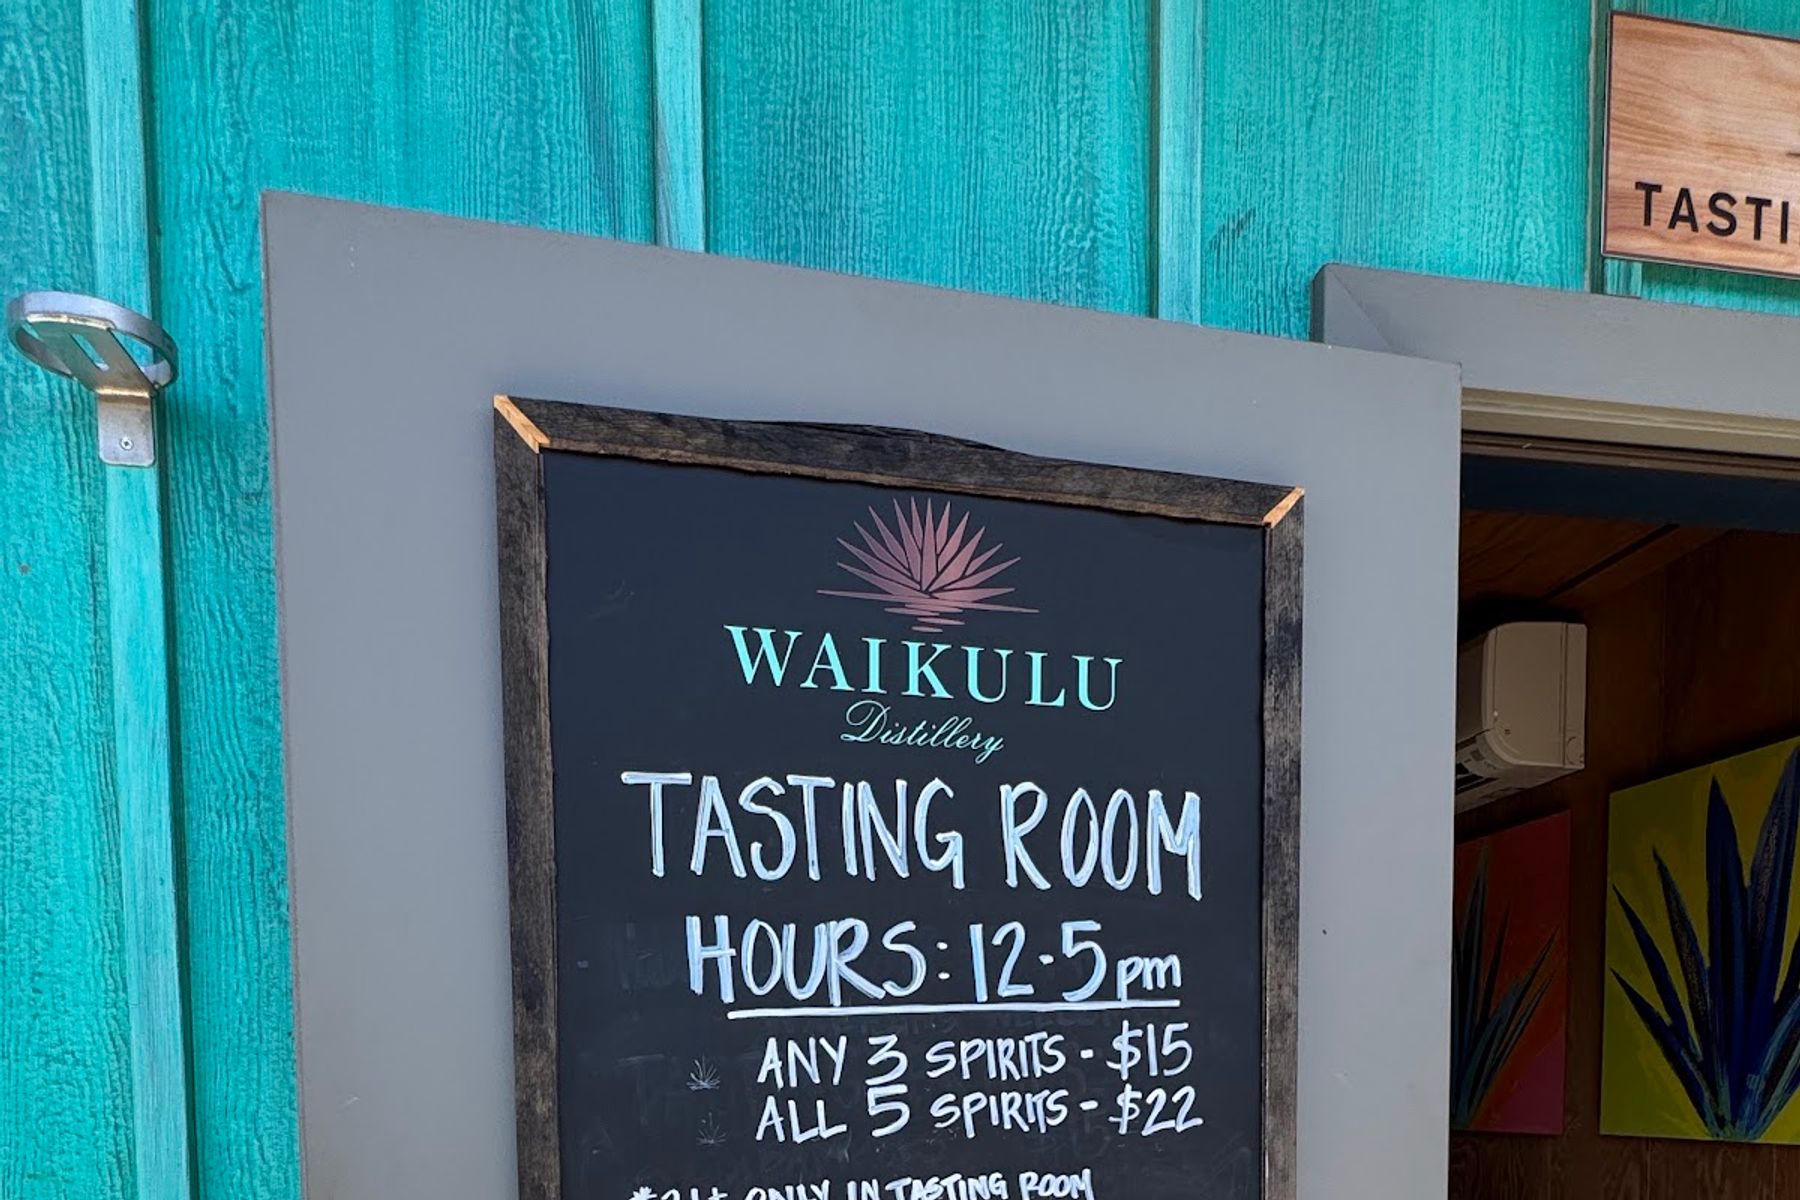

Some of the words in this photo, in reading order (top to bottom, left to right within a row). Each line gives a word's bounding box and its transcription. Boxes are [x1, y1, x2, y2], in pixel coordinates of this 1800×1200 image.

[724, 625, 1123, 711] WAIKULU
[841, 700, 1003, 764] Distillery
[621, 772, 964, 889] TASTING
[1000, 782, 1201, 900] ROOM
[686, 915, 949, 1004] HOURS:
[758, 1036, 846, 1088] ANY
[866, 1035, 907, 1085] 3
[926, 1032, 1065, 1080] SPIRITS
[1107, 1020, 1192, 1080] $15
[756, 1096, 847, 1143] ALL
[868, 1084, 909, 1137] 5
[930, 1090, 1068, 1138] SPIRITS
[1109, 1084, 1203, 1136] $22
